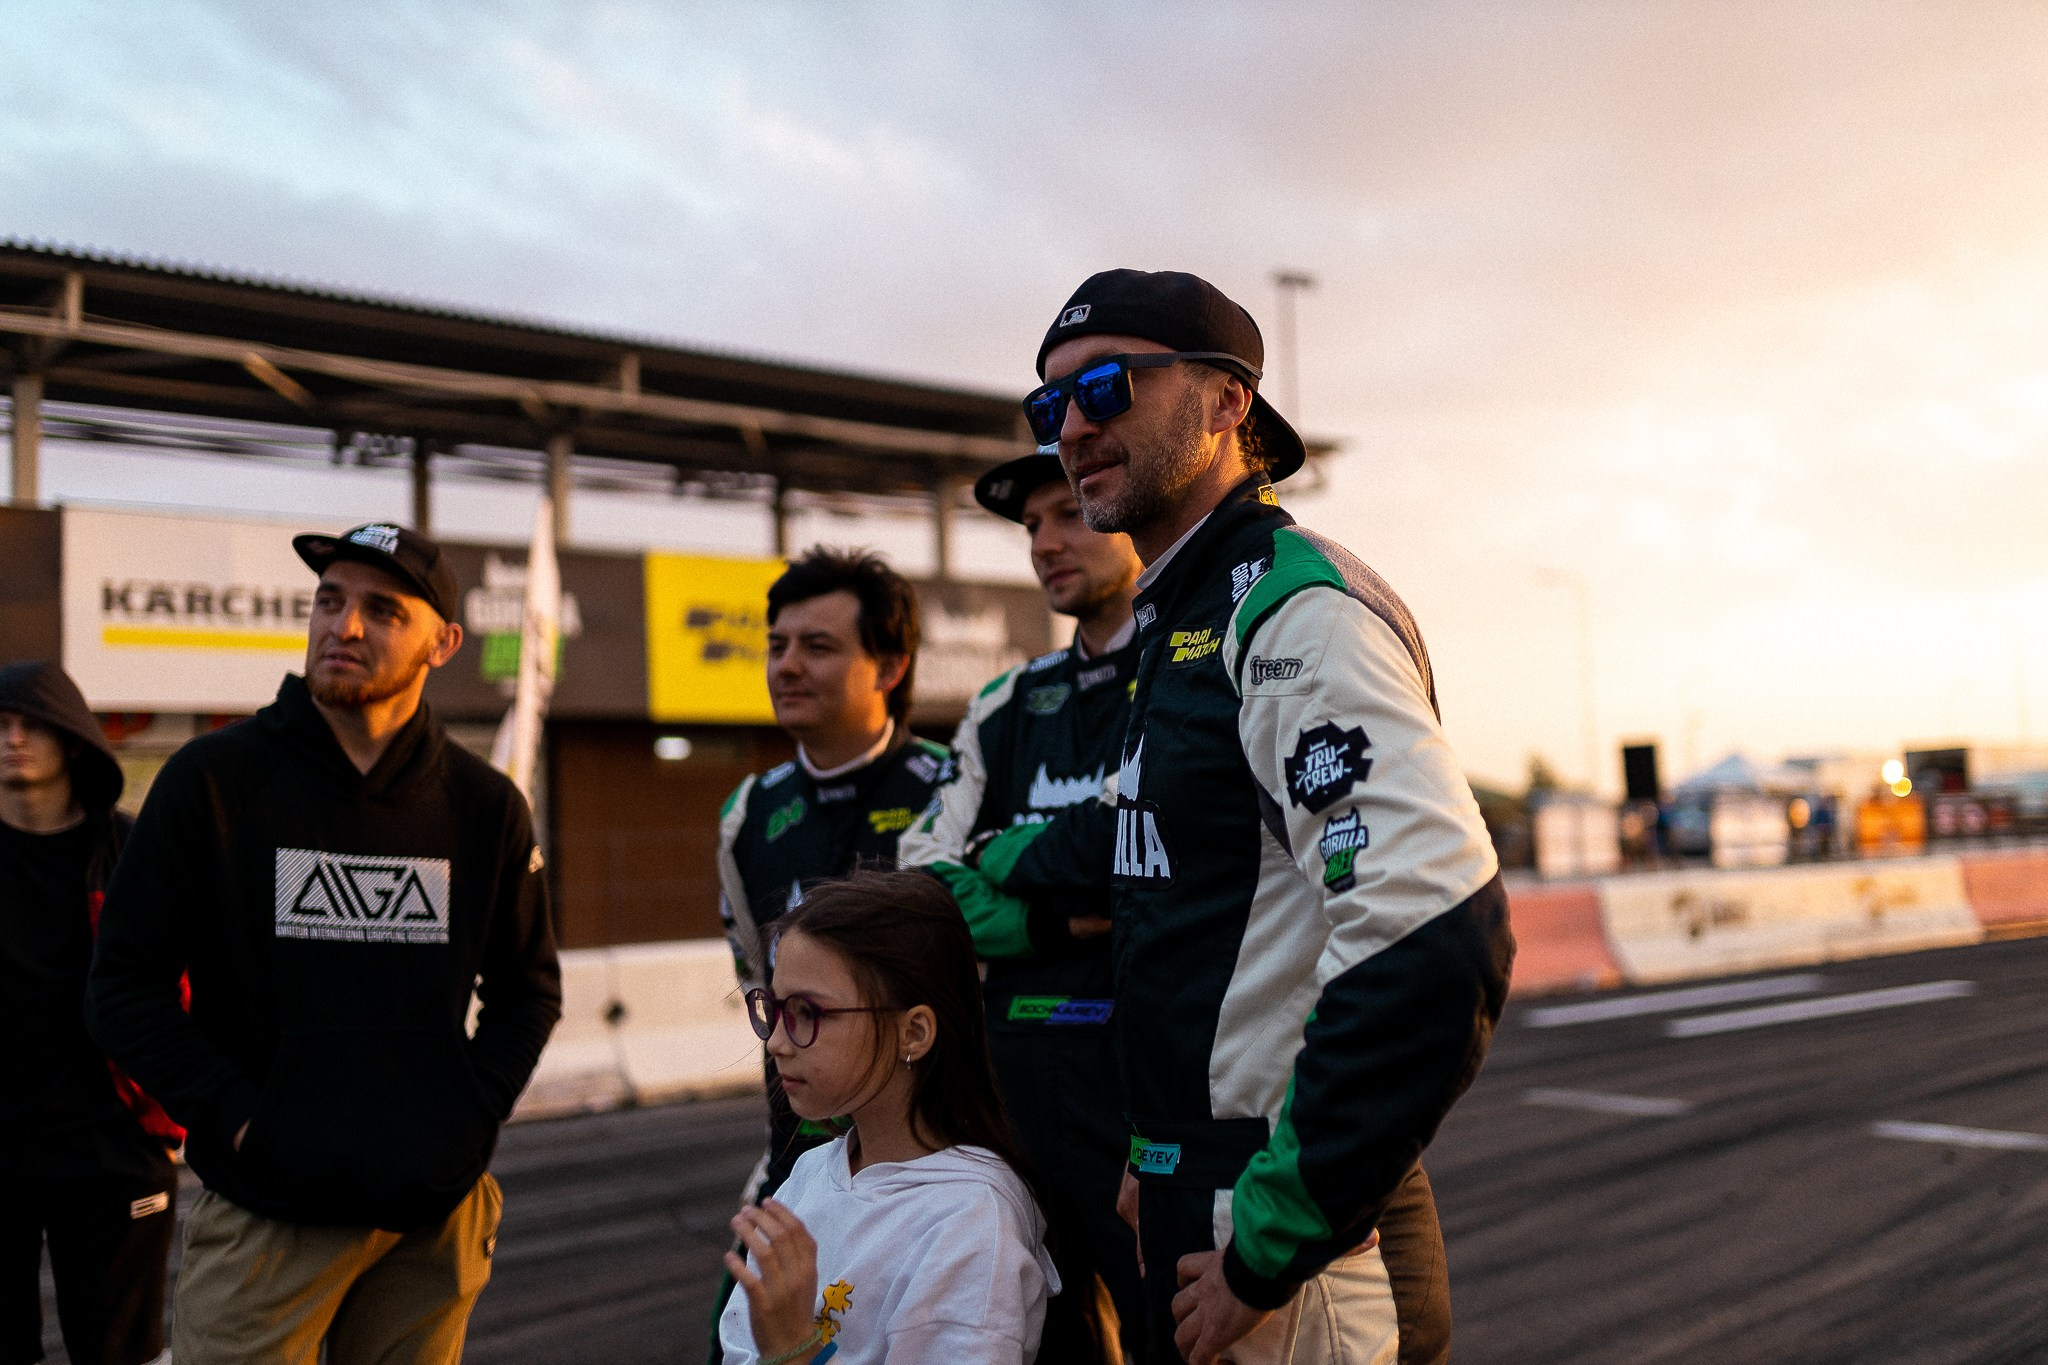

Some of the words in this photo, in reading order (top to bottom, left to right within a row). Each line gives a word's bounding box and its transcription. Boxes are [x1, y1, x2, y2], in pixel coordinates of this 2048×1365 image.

[1170, 628, 1212, 646] PARI
[1251, 657, 1302, 683] freem
[1305, 745, 1337, 774] TRU
[1304, 758, 1344, 796] CREW
[1320, 828, 1366, 861] GORILLA
